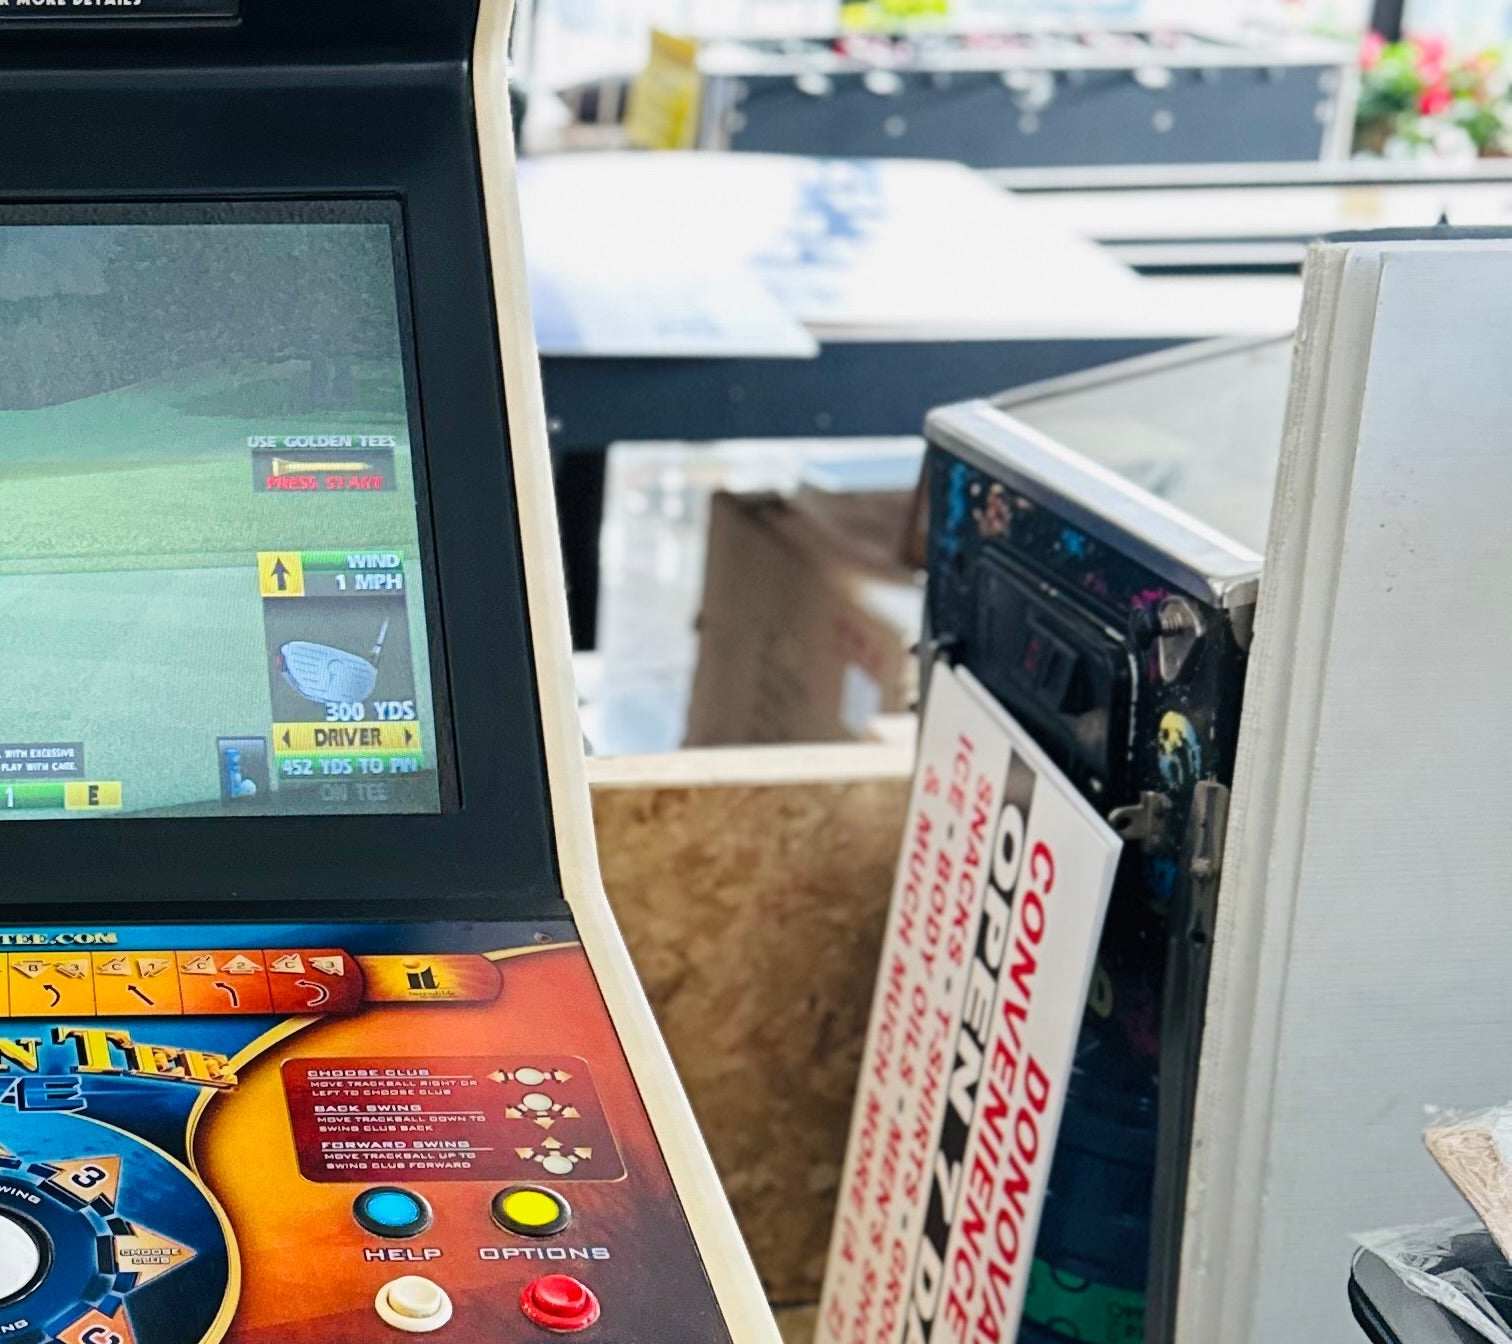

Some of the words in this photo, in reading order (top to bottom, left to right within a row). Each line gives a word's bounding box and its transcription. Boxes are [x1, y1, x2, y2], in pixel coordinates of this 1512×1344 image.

[247, 435, 277, 448] USE
[284, 435, 352, 448] GOLDEN
[358, 435, 396, 448] TEES
[266, 475, 318, 490] PRESS
[326, 475, 384, 489] START
[347, 553, 401, 568] WIND
[335, 574, 346, 590] 1
[355, 574, 402, 590] MPH
[326, 702, 365, 722] 300
[375, 700, 416, 720] YDS
[314, 728, 382, 747] DRIVER
[282, 759, 313, 776] 452
[320, 758, 353, 774] YDS
[359, 758, 383, 773] TO
[390, 757, 418, 773] PIN
[948, 733, 973, 816] ICE
[6, 787, 15, 809] 1
[88, 785, 100, 806] E
[945, 775, 992, 967] SNACKS
[921, 850, 953, 978] BODY
[948, 804, 1024, 1125] OPEN
[51, 1025, 238, 1088] TEE
[307, 1069, 380, 1077] CHOOSE
[386, 1069, 431, 1077] CLUB
[314, 1105, 361, 1113] BACK
[321, 1141, 407, 1149] FORWARD
[413, 1140, 471, 1149] SWING
[71, 1165, 106, 1188] 3
[935, 1149, 963, 1225] 7
[363, 1247, 442, 1262] HELP
[479, 1247, 610, 1261] OPTIONS
